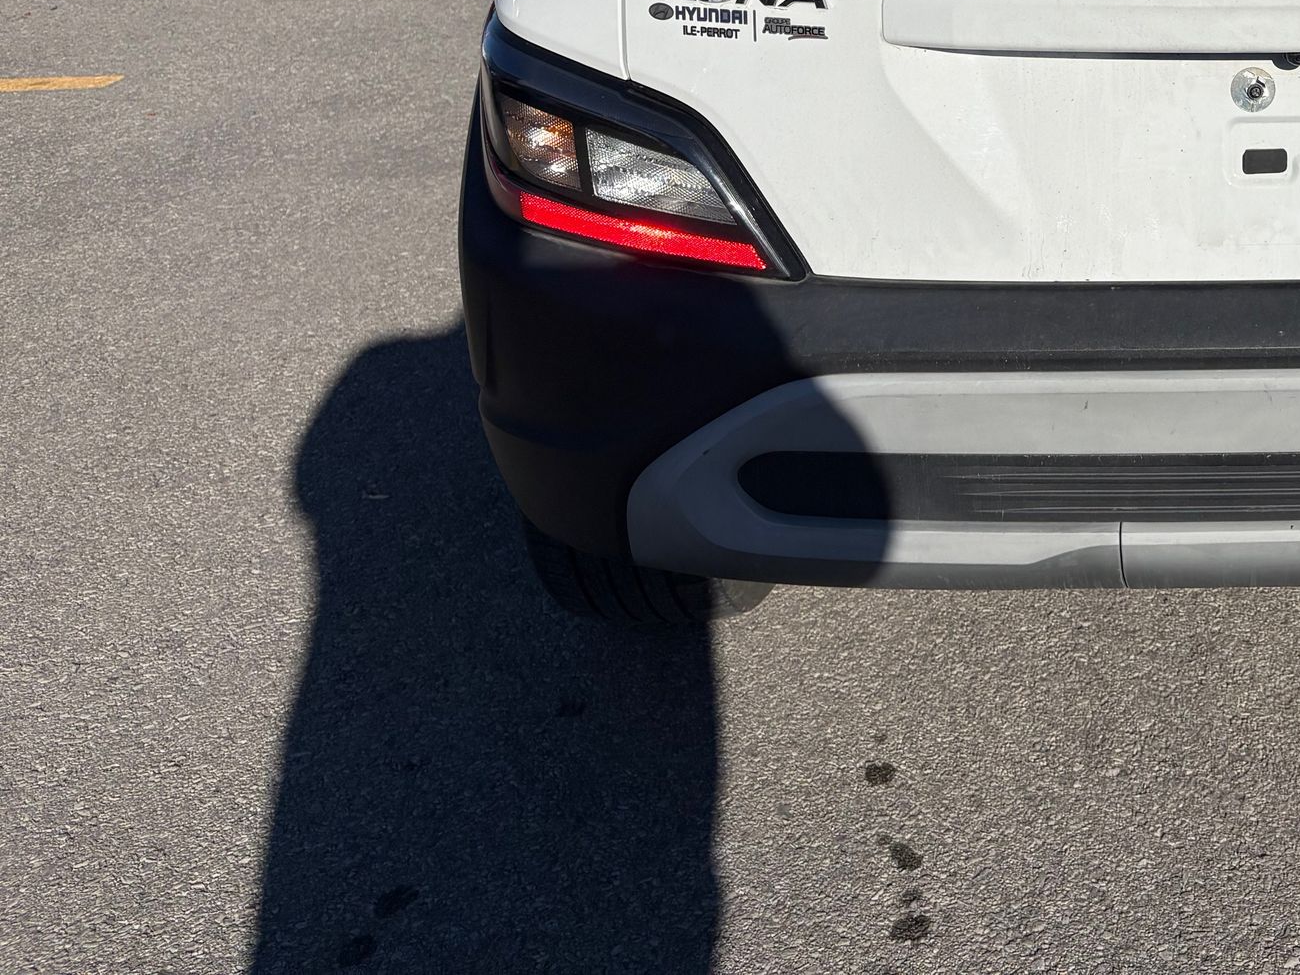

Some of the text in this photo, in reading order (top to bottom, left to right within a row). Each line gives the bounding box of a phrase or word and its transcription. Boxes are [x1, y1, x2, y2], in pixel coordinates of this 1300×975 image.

[675, 5, 748, 25] HYUNDAI
[682, 24, 741, 39] ILE-PERROT
[762, 24, 826, 36] AUTOFORCE
